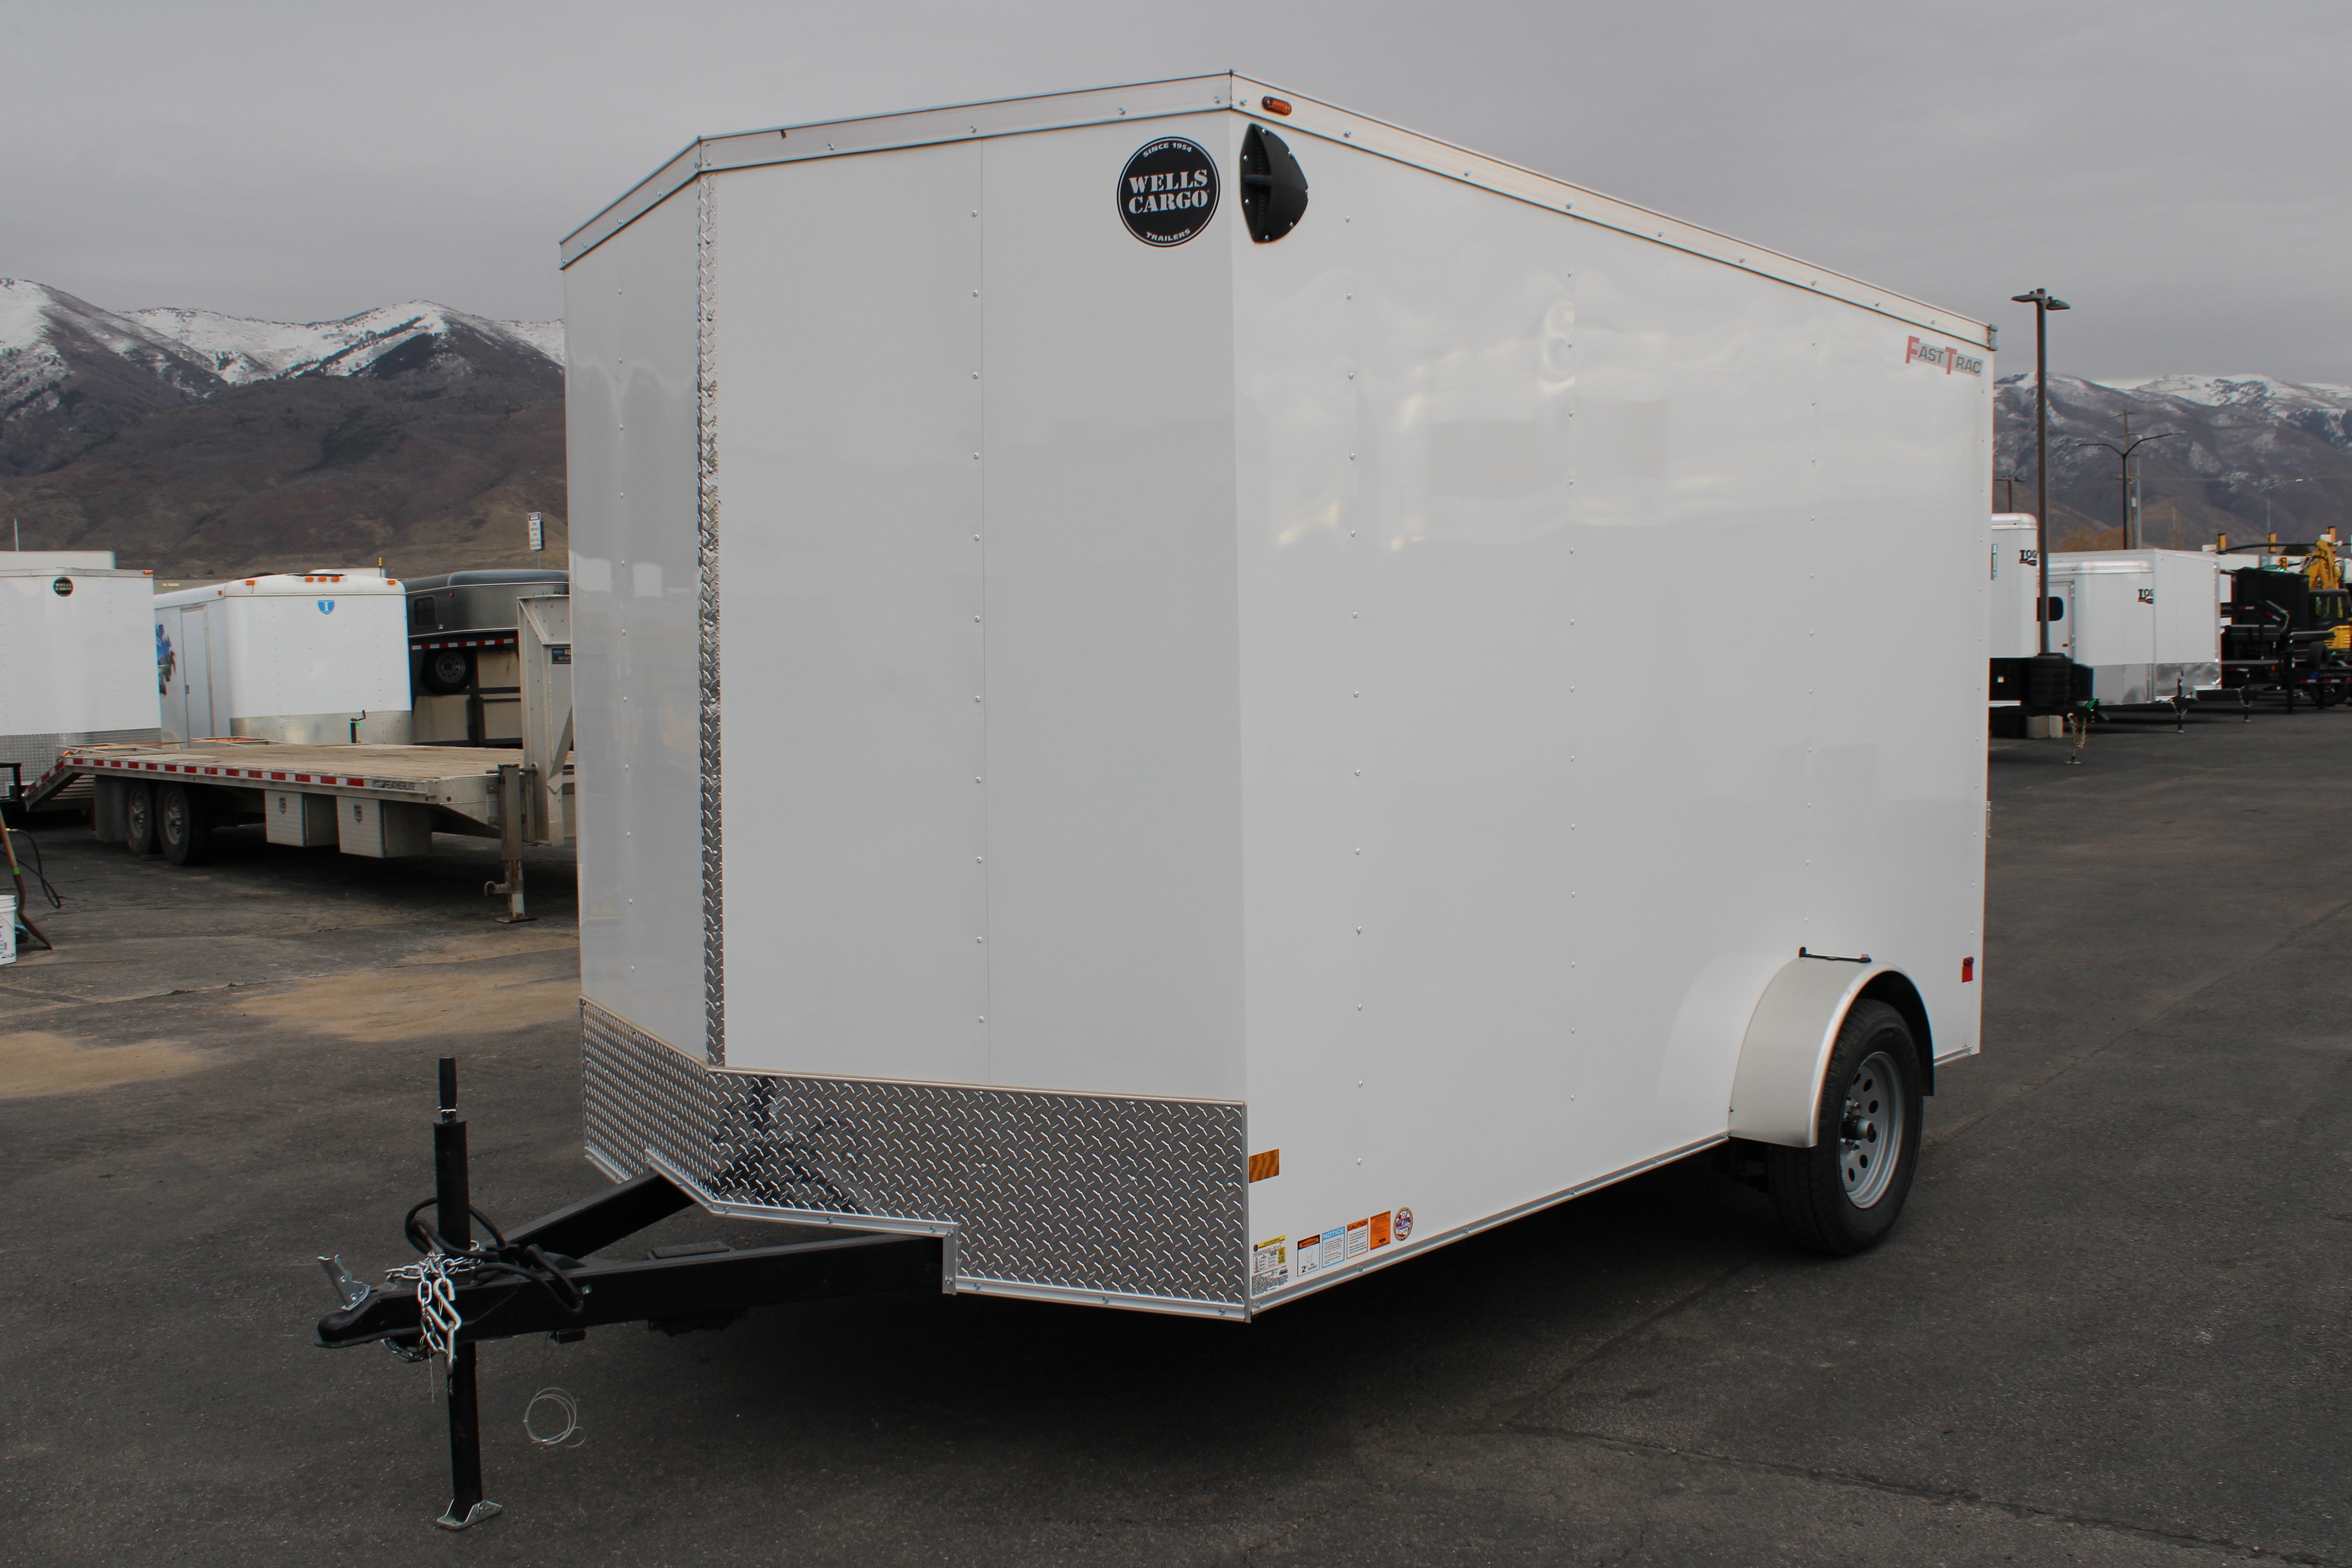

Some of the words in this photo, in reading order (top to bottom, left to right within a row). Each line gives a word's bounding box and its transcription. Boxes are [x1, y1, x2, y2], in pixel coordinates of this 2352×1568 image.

[1143, 142, 1169, 158] SINCE
[1172, 143, 1192, 152] 1954
[1129, 169, 1208, 194] WELLS
[1129, 190, 1208, 214] CARGO
[1146, 228, 1191, 242] TRAILERS
[385, 780, 415, 791] FEATHERLITE
[1323, 1227, 1344, 1239] NOTICE
[1348, 1221, 1368, 1231] CAUTION
